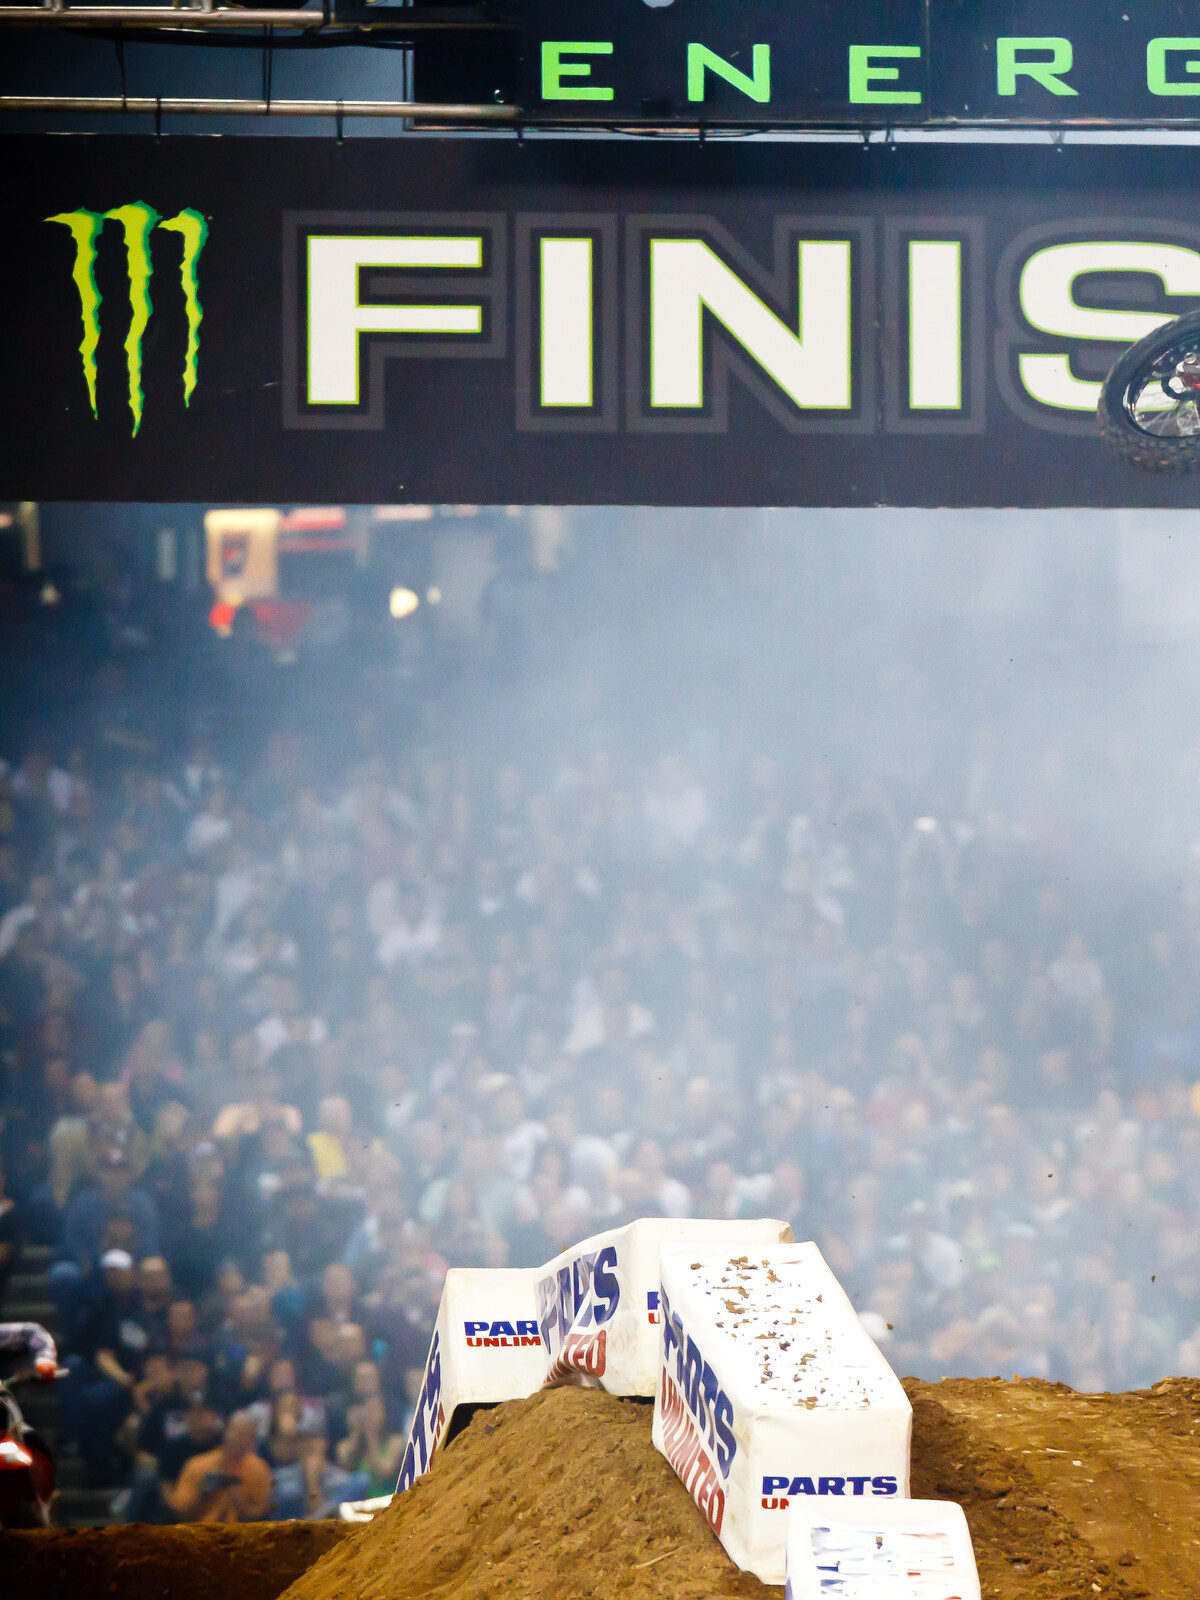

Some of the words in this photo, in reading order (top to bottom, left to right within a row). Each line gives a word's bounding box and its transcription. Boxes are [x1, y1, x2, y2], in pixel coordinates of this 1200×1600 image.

[464, 1320, 540, 1337] PAR
[466, 1336, 542, 1348] UNLIM
[762, 1476, 898, 1496] PARTS
